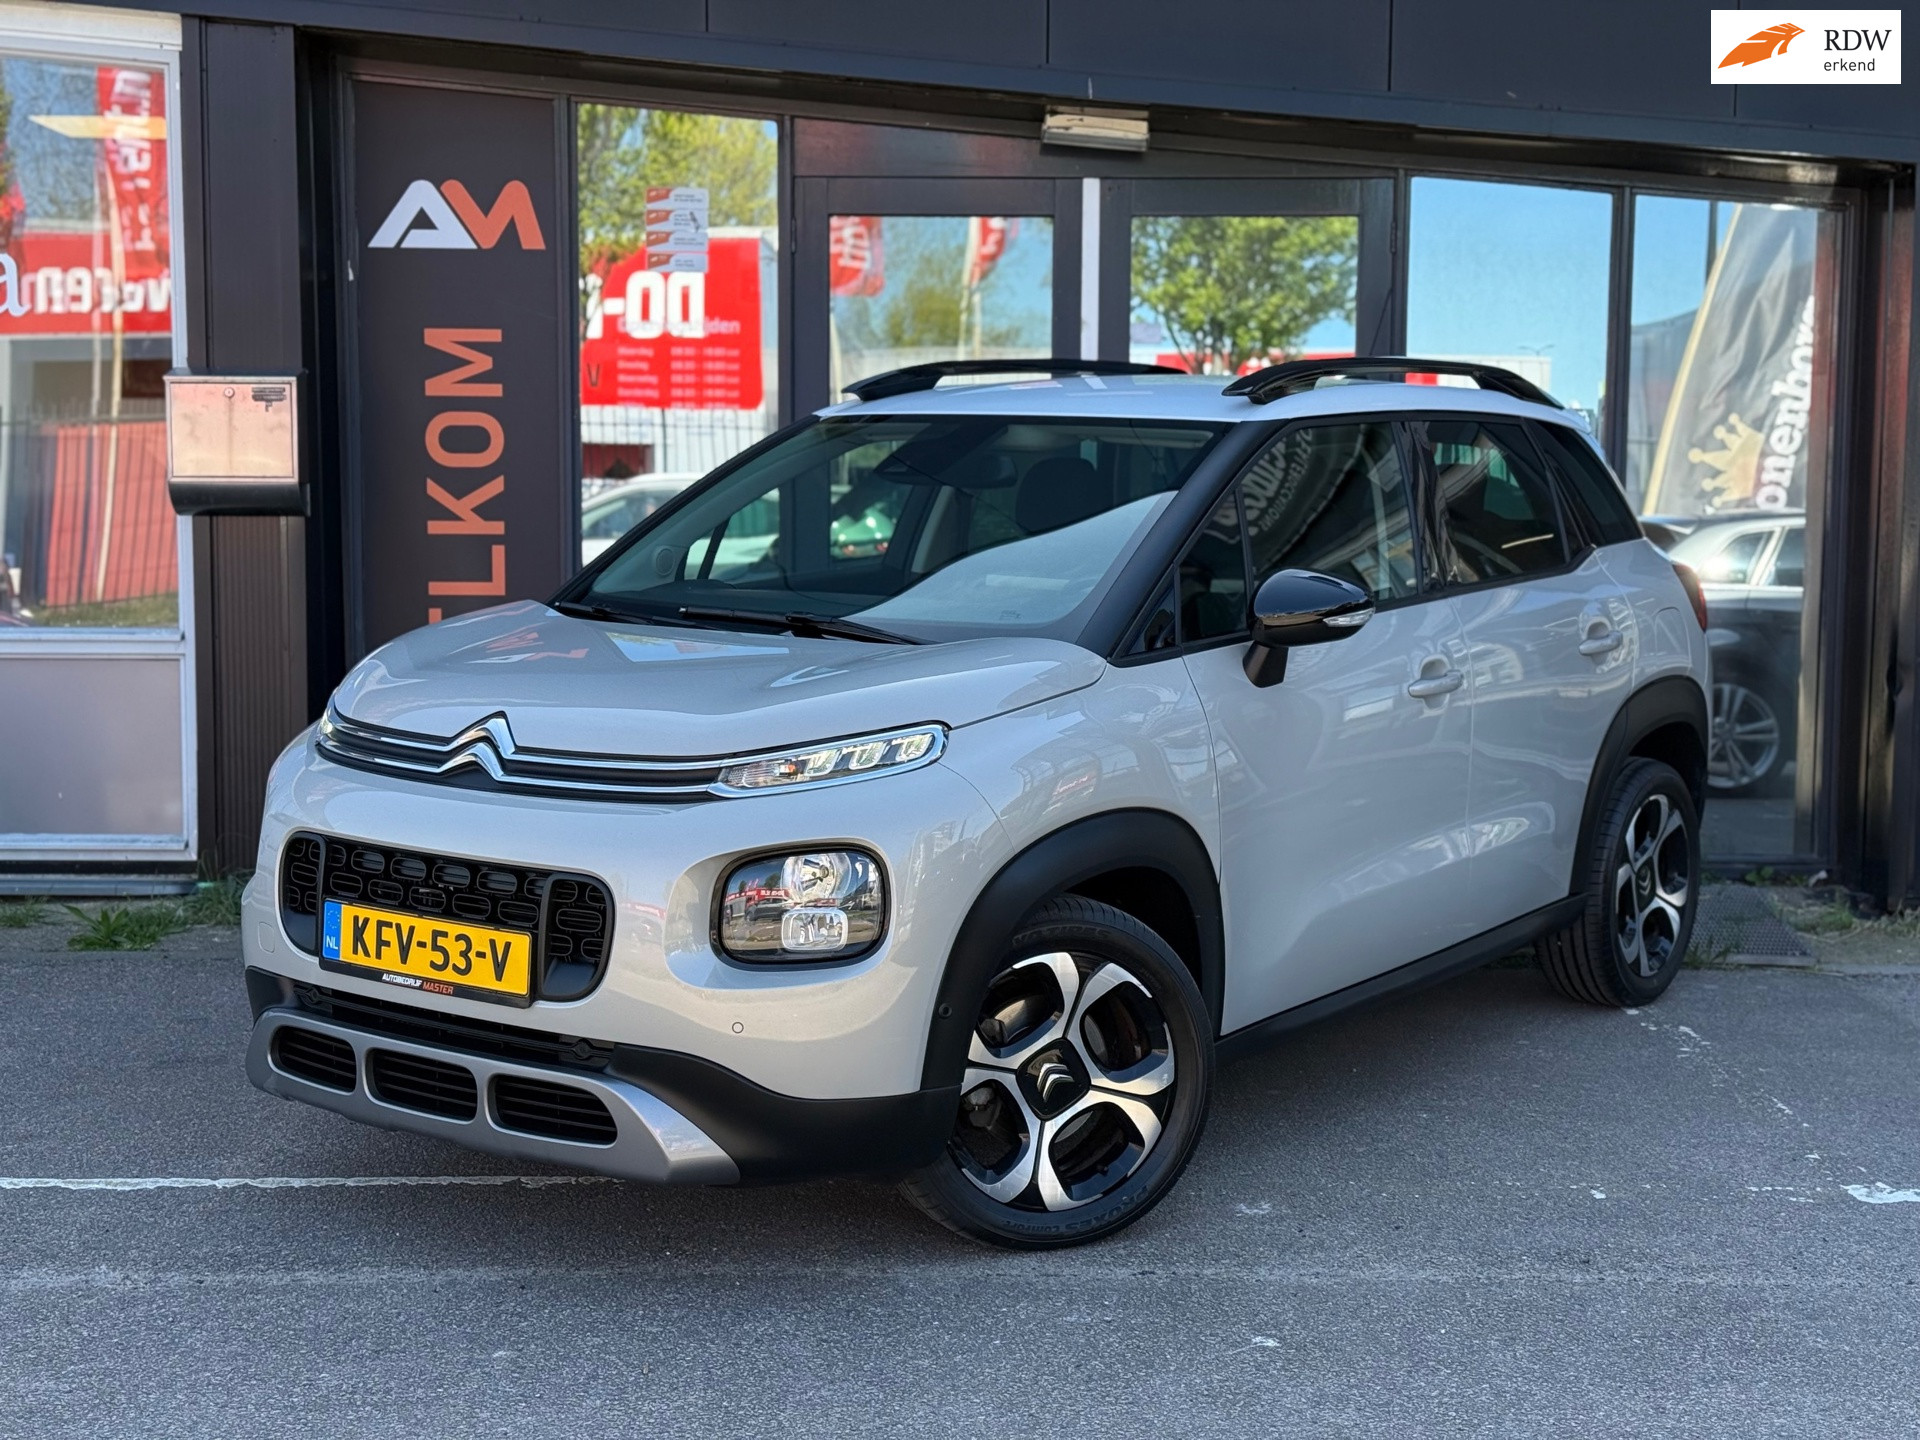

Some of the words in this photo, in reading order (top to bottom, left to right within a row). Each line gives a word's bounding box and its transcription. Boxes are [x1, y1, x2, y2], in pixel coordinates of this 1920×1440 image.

[423, 327, 506, 625] LKOM
[325, 935, 339, 950] NL
[352, 914, 512, 982] KFV-53-V
[382, 972, 423, 988] AUTOBEDRIJF
[422, 981, 454, 995] MASTER
